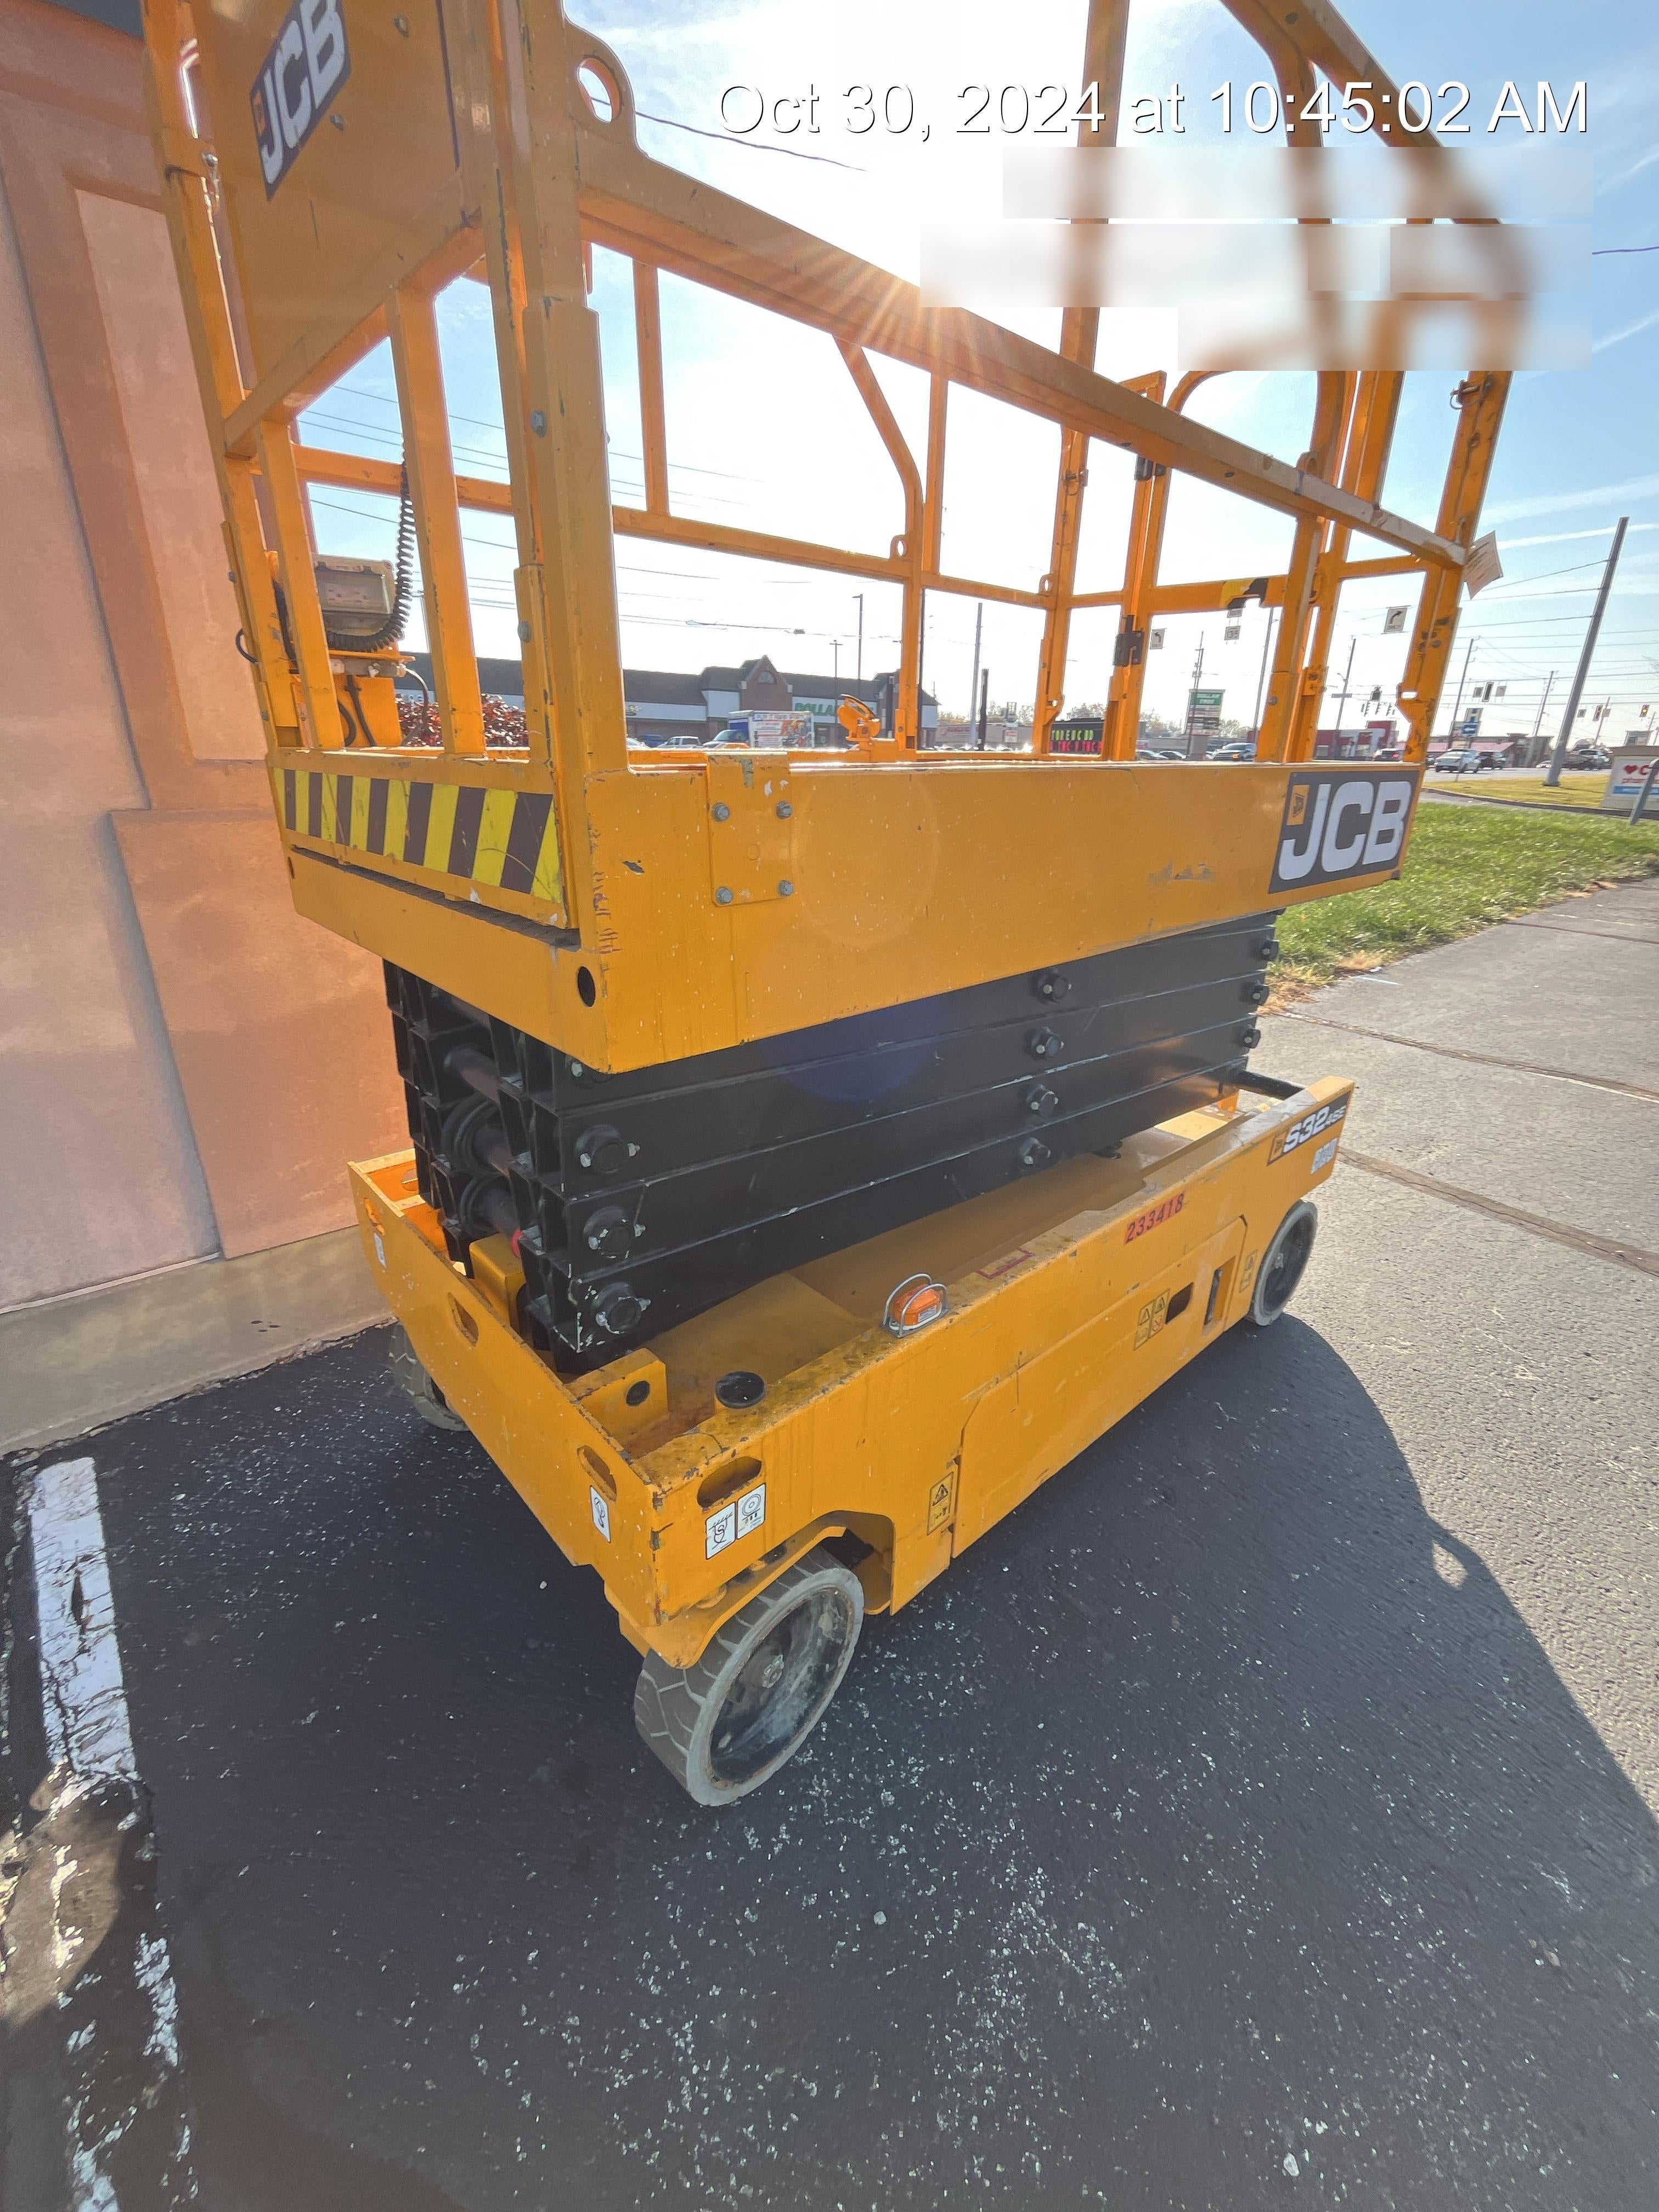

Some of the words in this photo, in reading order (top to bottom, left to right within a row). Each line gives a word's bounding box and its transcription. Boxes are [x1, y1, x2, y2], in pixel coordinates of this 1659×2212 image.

[261, 0, 345, 184] JCB
[1278, 781, 1412, 881] JCB
[1126, 1193, 1184, 1244] 233418
